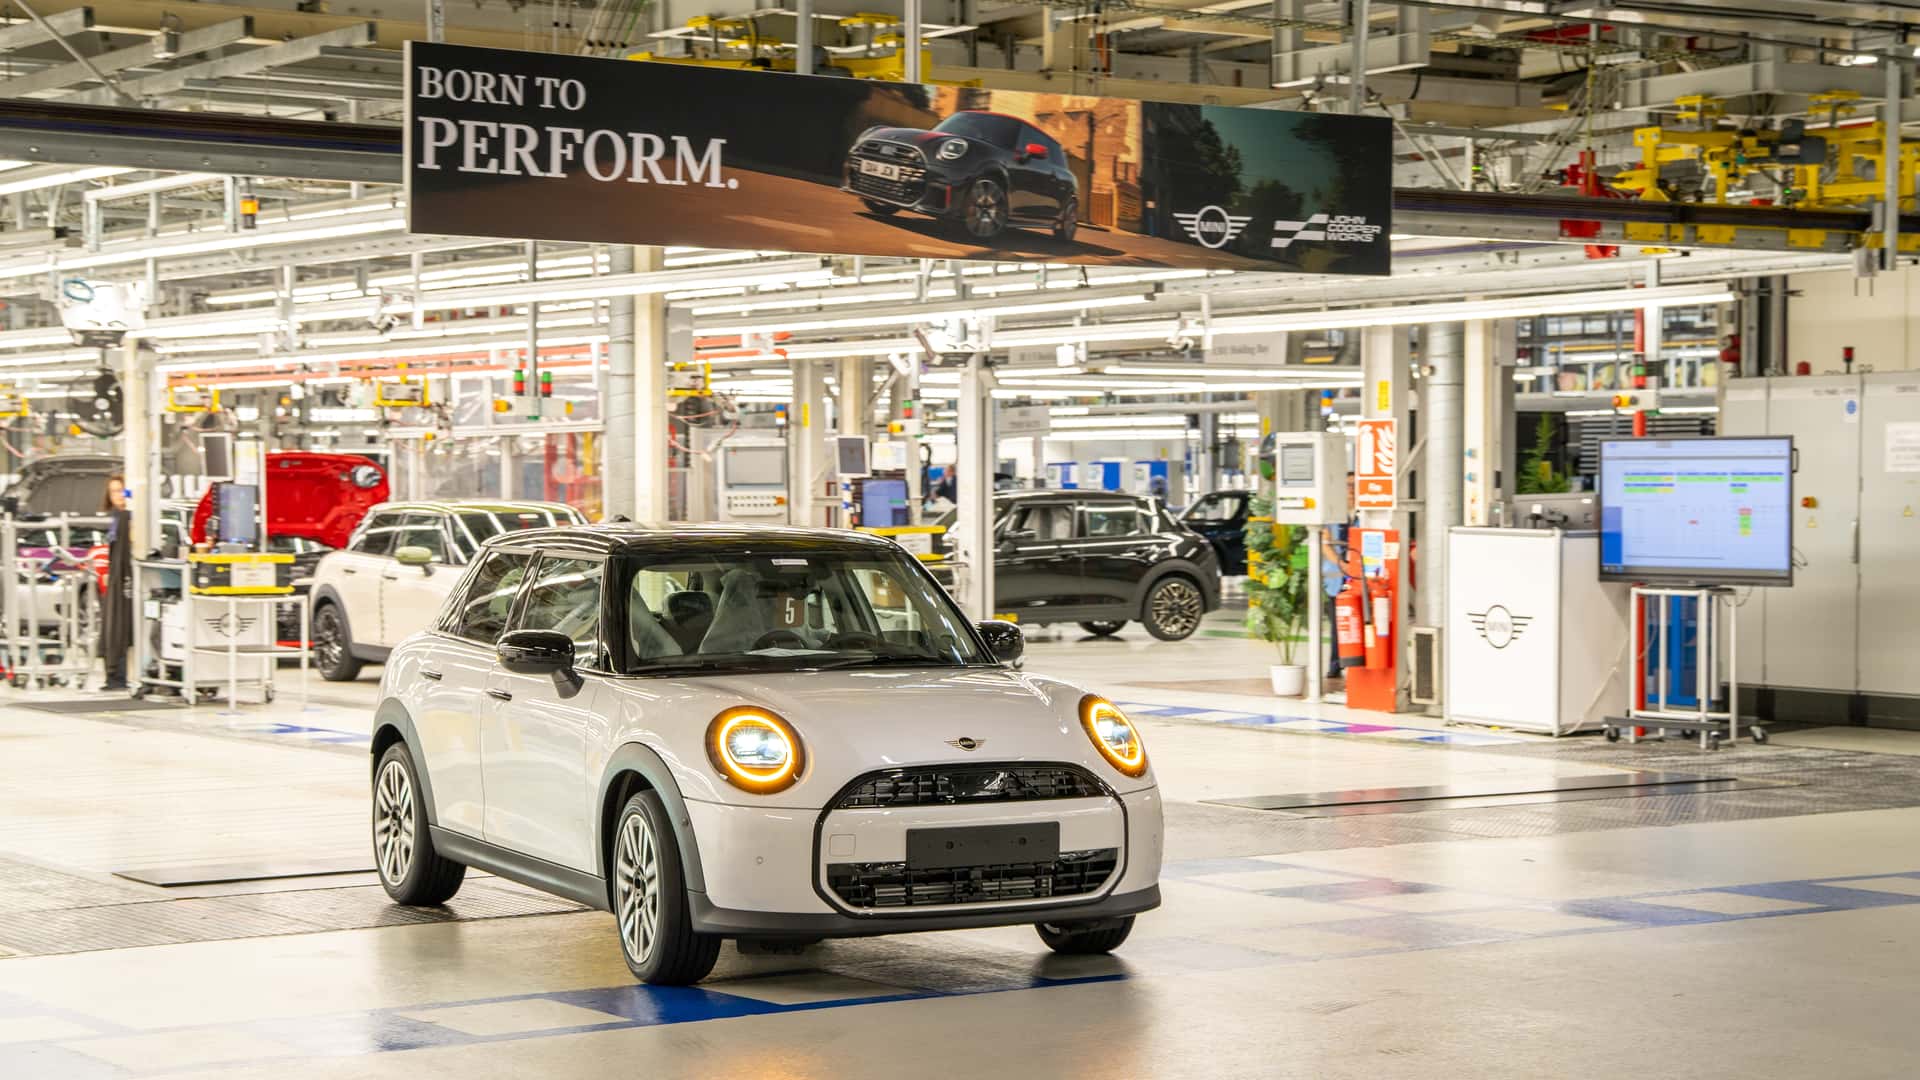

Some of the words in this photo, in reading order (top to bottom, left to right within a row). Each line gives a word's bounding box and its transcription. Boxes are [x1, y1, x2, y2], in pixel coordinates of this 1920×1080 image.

[417, 65, 526, 106] BORN
[535, 76, 587, 111] TO
[417, 115, 739, 189] PERFORM.
[1329, 215, 1366, 224] JOHN
[1199, 221, 1226, 233] MINI
[1327, 224, 1382, 234] COOPER
[1327, 233, 1374, 242] WORKS
[785, 597, 795, 624] 5
